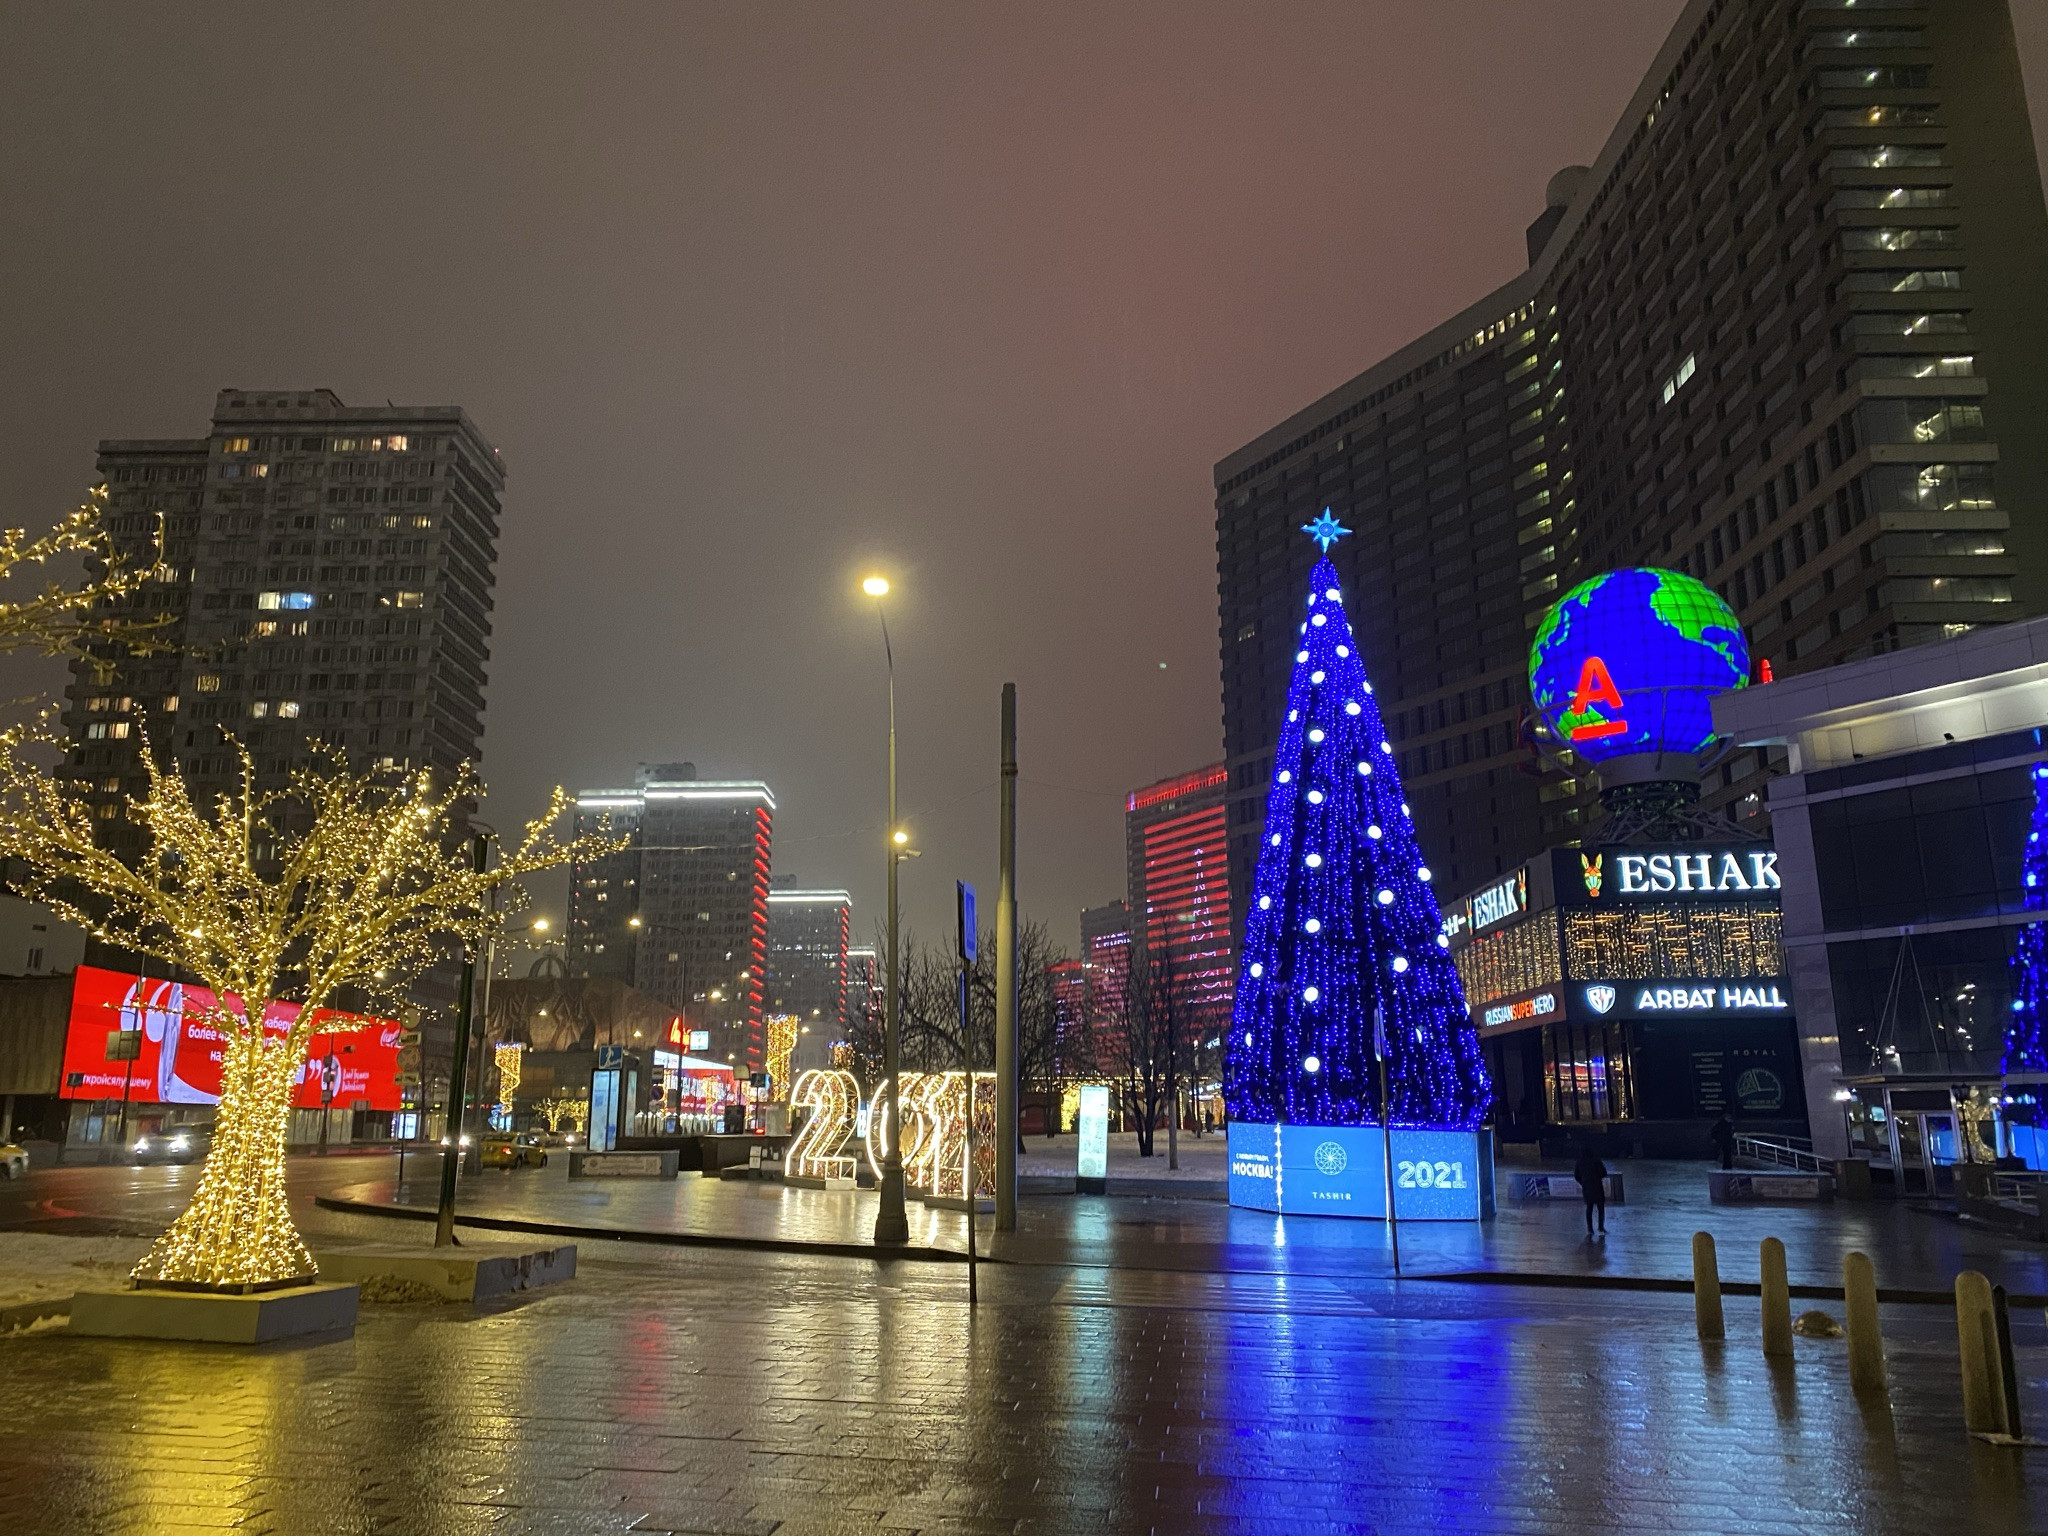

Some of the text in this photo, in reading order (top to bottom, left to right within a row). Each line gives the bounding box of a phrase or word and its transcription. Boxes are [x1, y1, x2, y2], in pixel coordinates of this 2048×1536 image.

[1617, 853, 1782, 892] ESHAK
[1474, 878, 1519, 930] ESHAK
[1638, 987, 1788, 1010] ARBAT HALL
[188, 1024, 216, 1041] более
[1733, 1049, 1777, 1057] ROYAL
[1232, 1161, 1274, 1179] МОСКВА!
[1397, 1160, 1467, 1189] 2021
[1312, 1191, 1352, 1201] TASHIR
